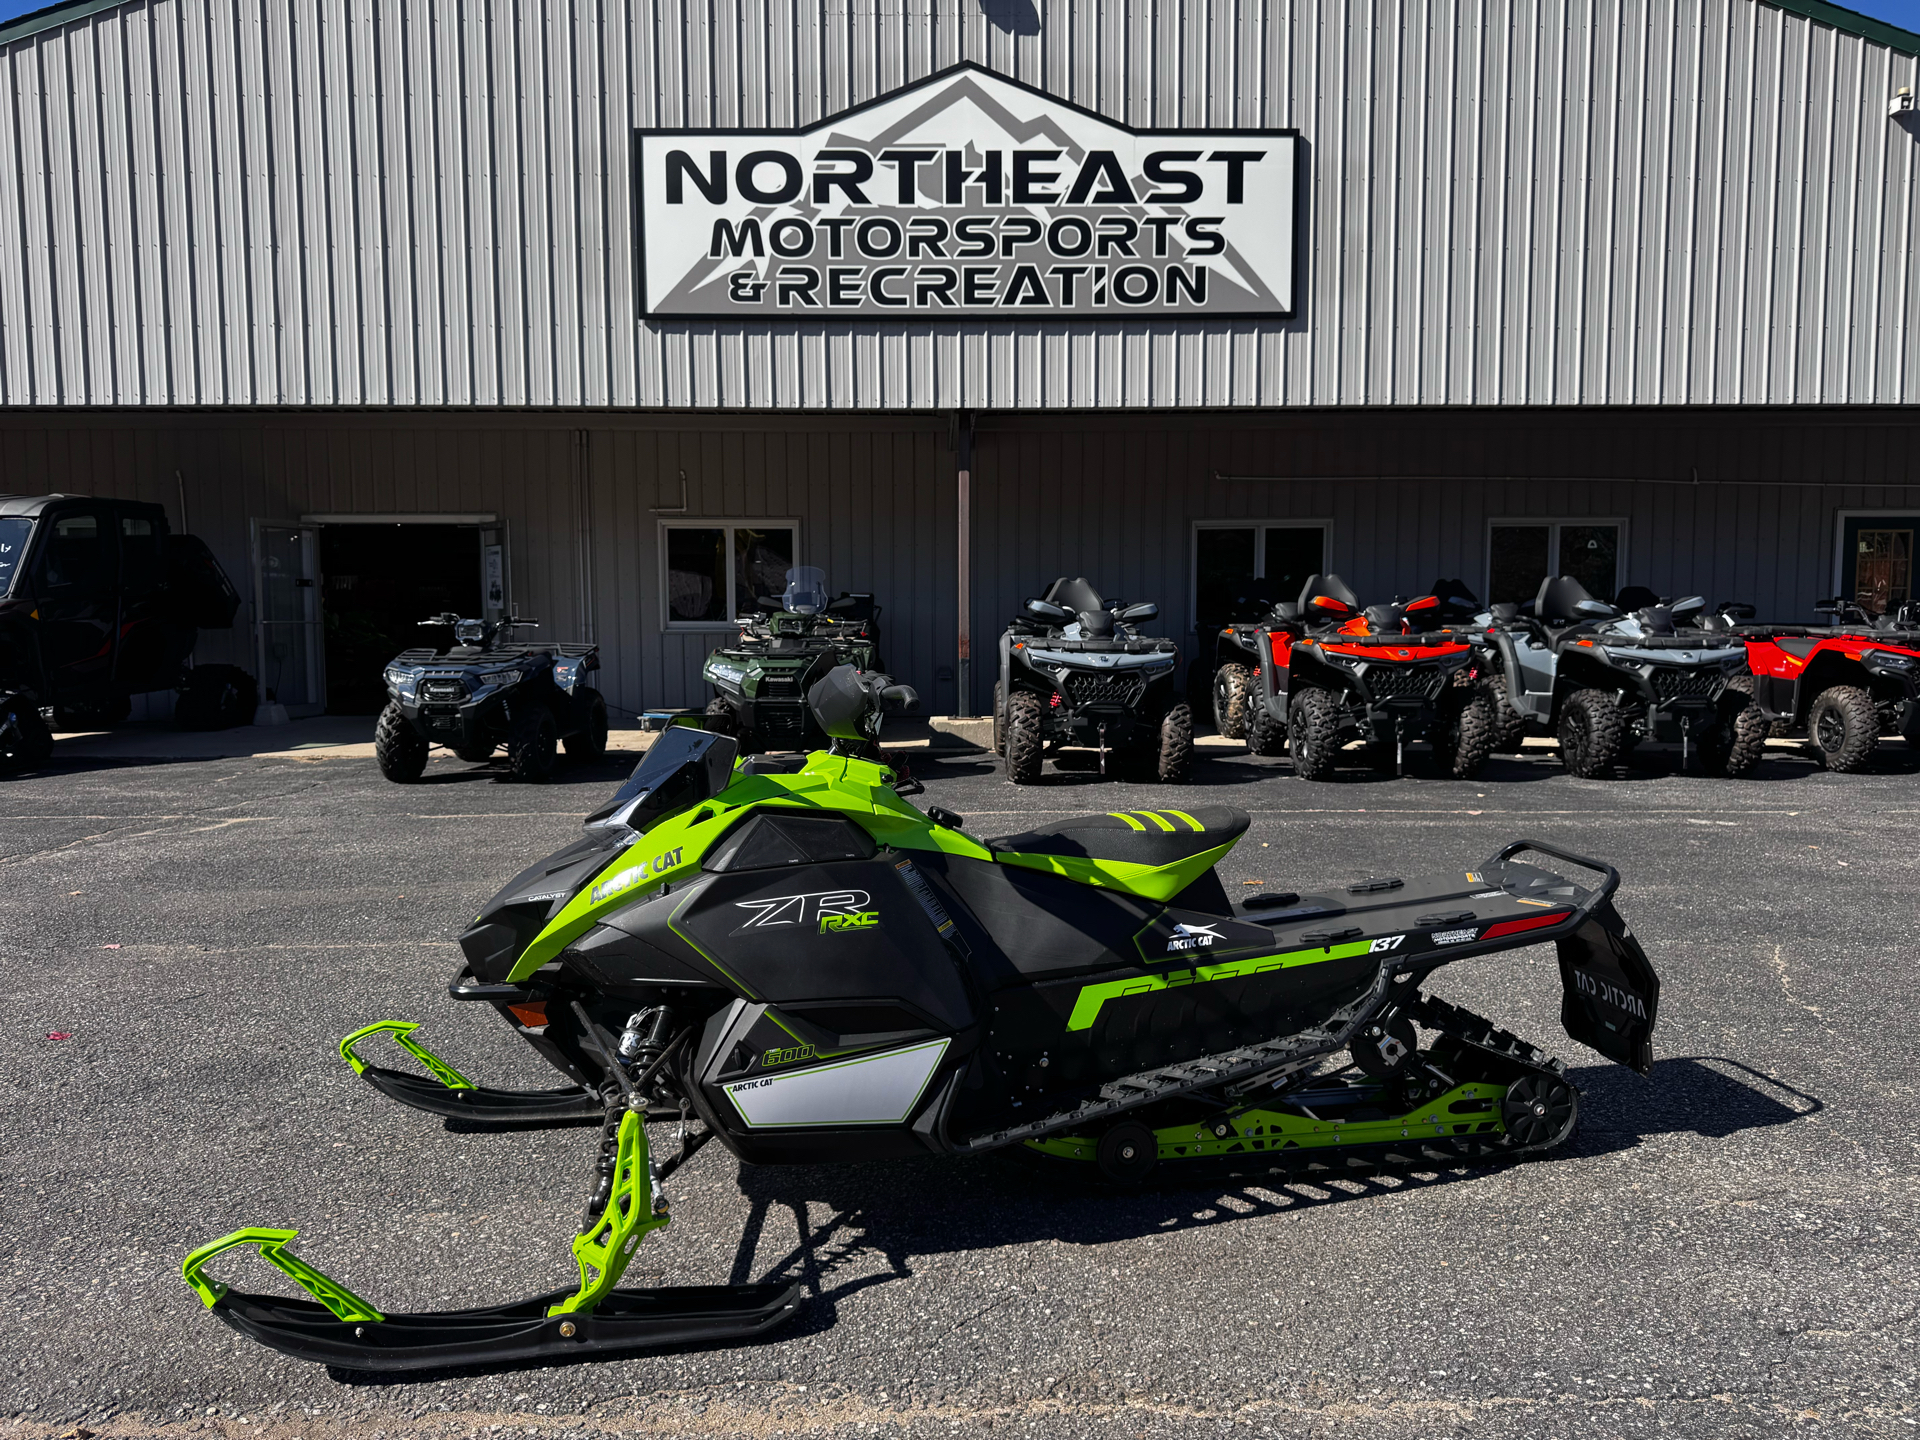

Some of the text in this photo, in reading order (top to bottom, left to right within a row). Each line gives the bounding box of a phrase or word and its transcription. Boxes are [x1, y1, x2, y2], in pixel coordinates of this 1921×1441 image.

[665, 149, 1268, 206] NORTHEAST
[708, 216, 1227, 259] MOTORSPORTS
[764, 675, 794, 683] Kawasaki
[590, 846, 684, 905] ARCTIC CAT
[528, 892, 566, 902] CATALYST
[733, 889, 872, 929] ZR
[820, 911, 880, 934] RXC
[1166, 936, 1213, 952] ARCTIC CAT
[1368, 934, 1406, 954] 137
[762, 1044, 815, 1066] 600
[733, 1078, 774, 1092] ARCTIC CAT
